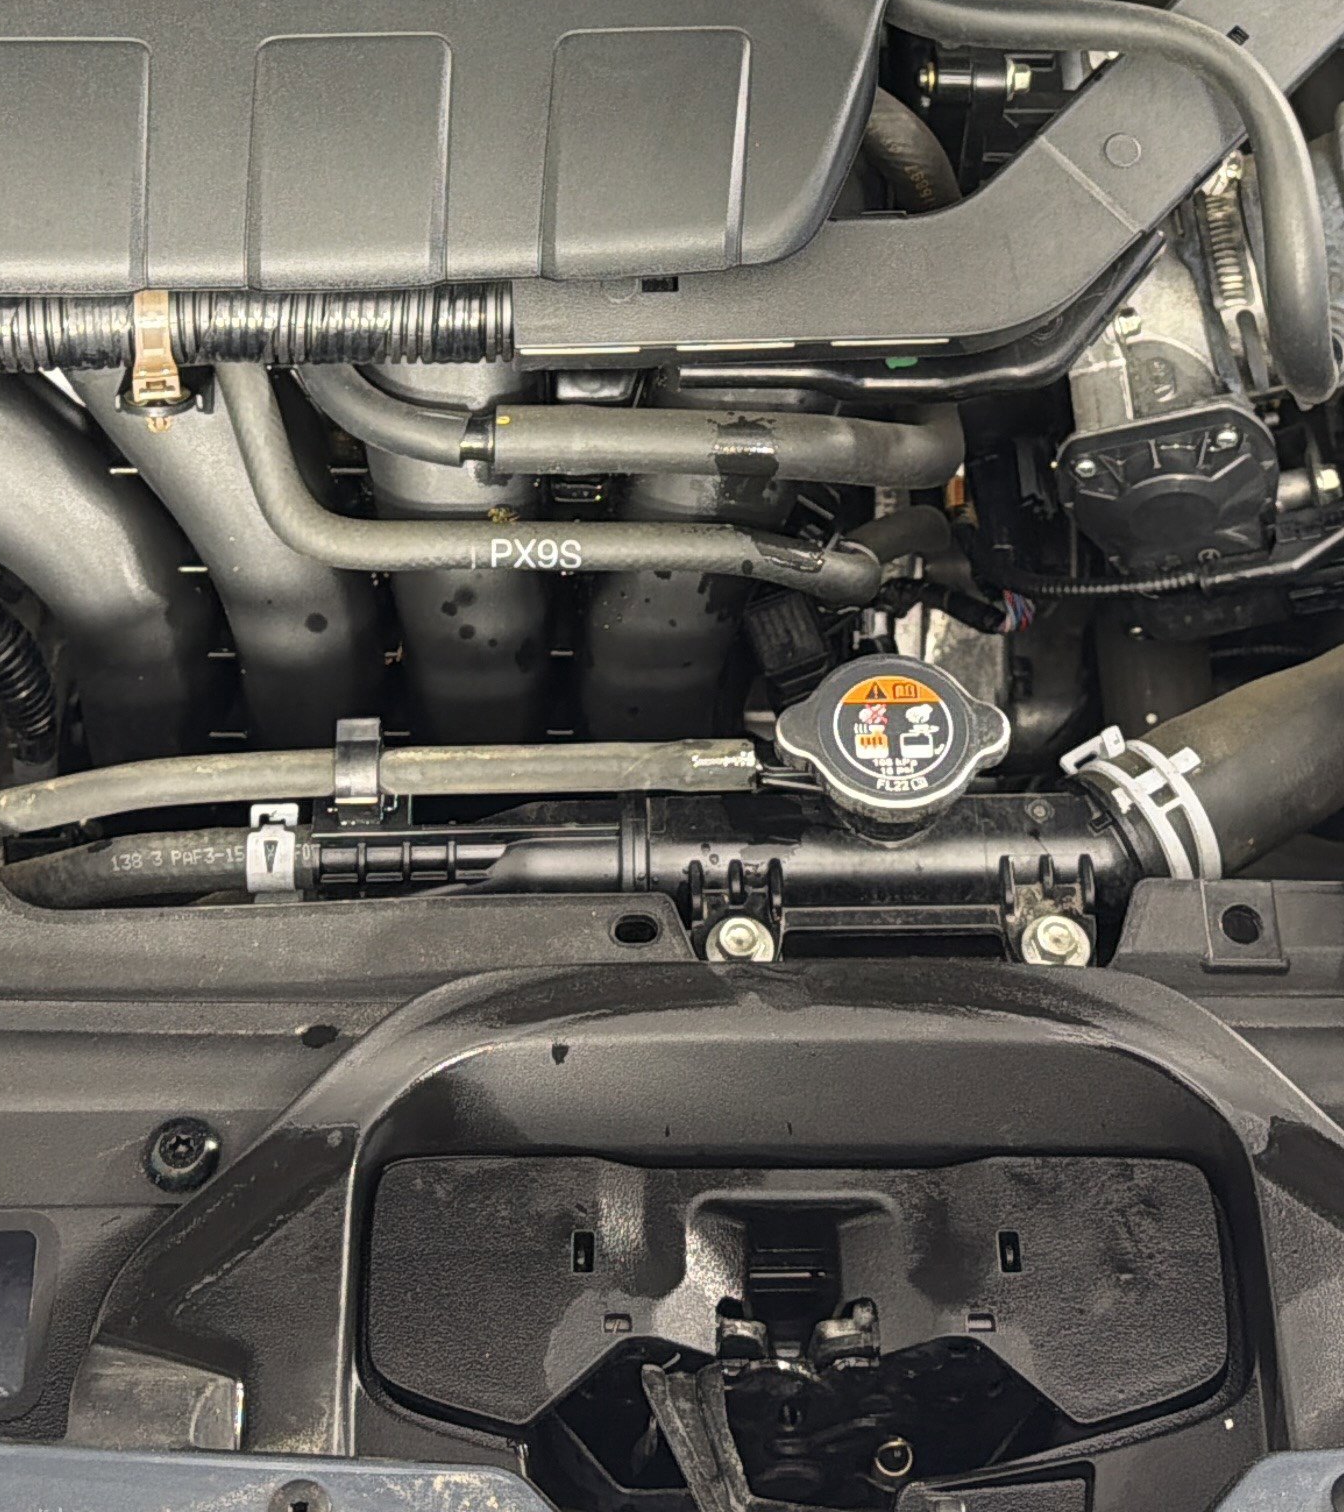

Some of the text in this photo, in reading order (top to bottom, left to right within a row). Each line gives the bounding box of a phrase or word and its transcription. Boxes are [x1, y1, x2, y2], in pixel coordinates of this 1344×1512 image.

[490, 538, 583, 569] PX9S
[110, 852, 144, 872] 138
[149, 850, 163, 867] 3
